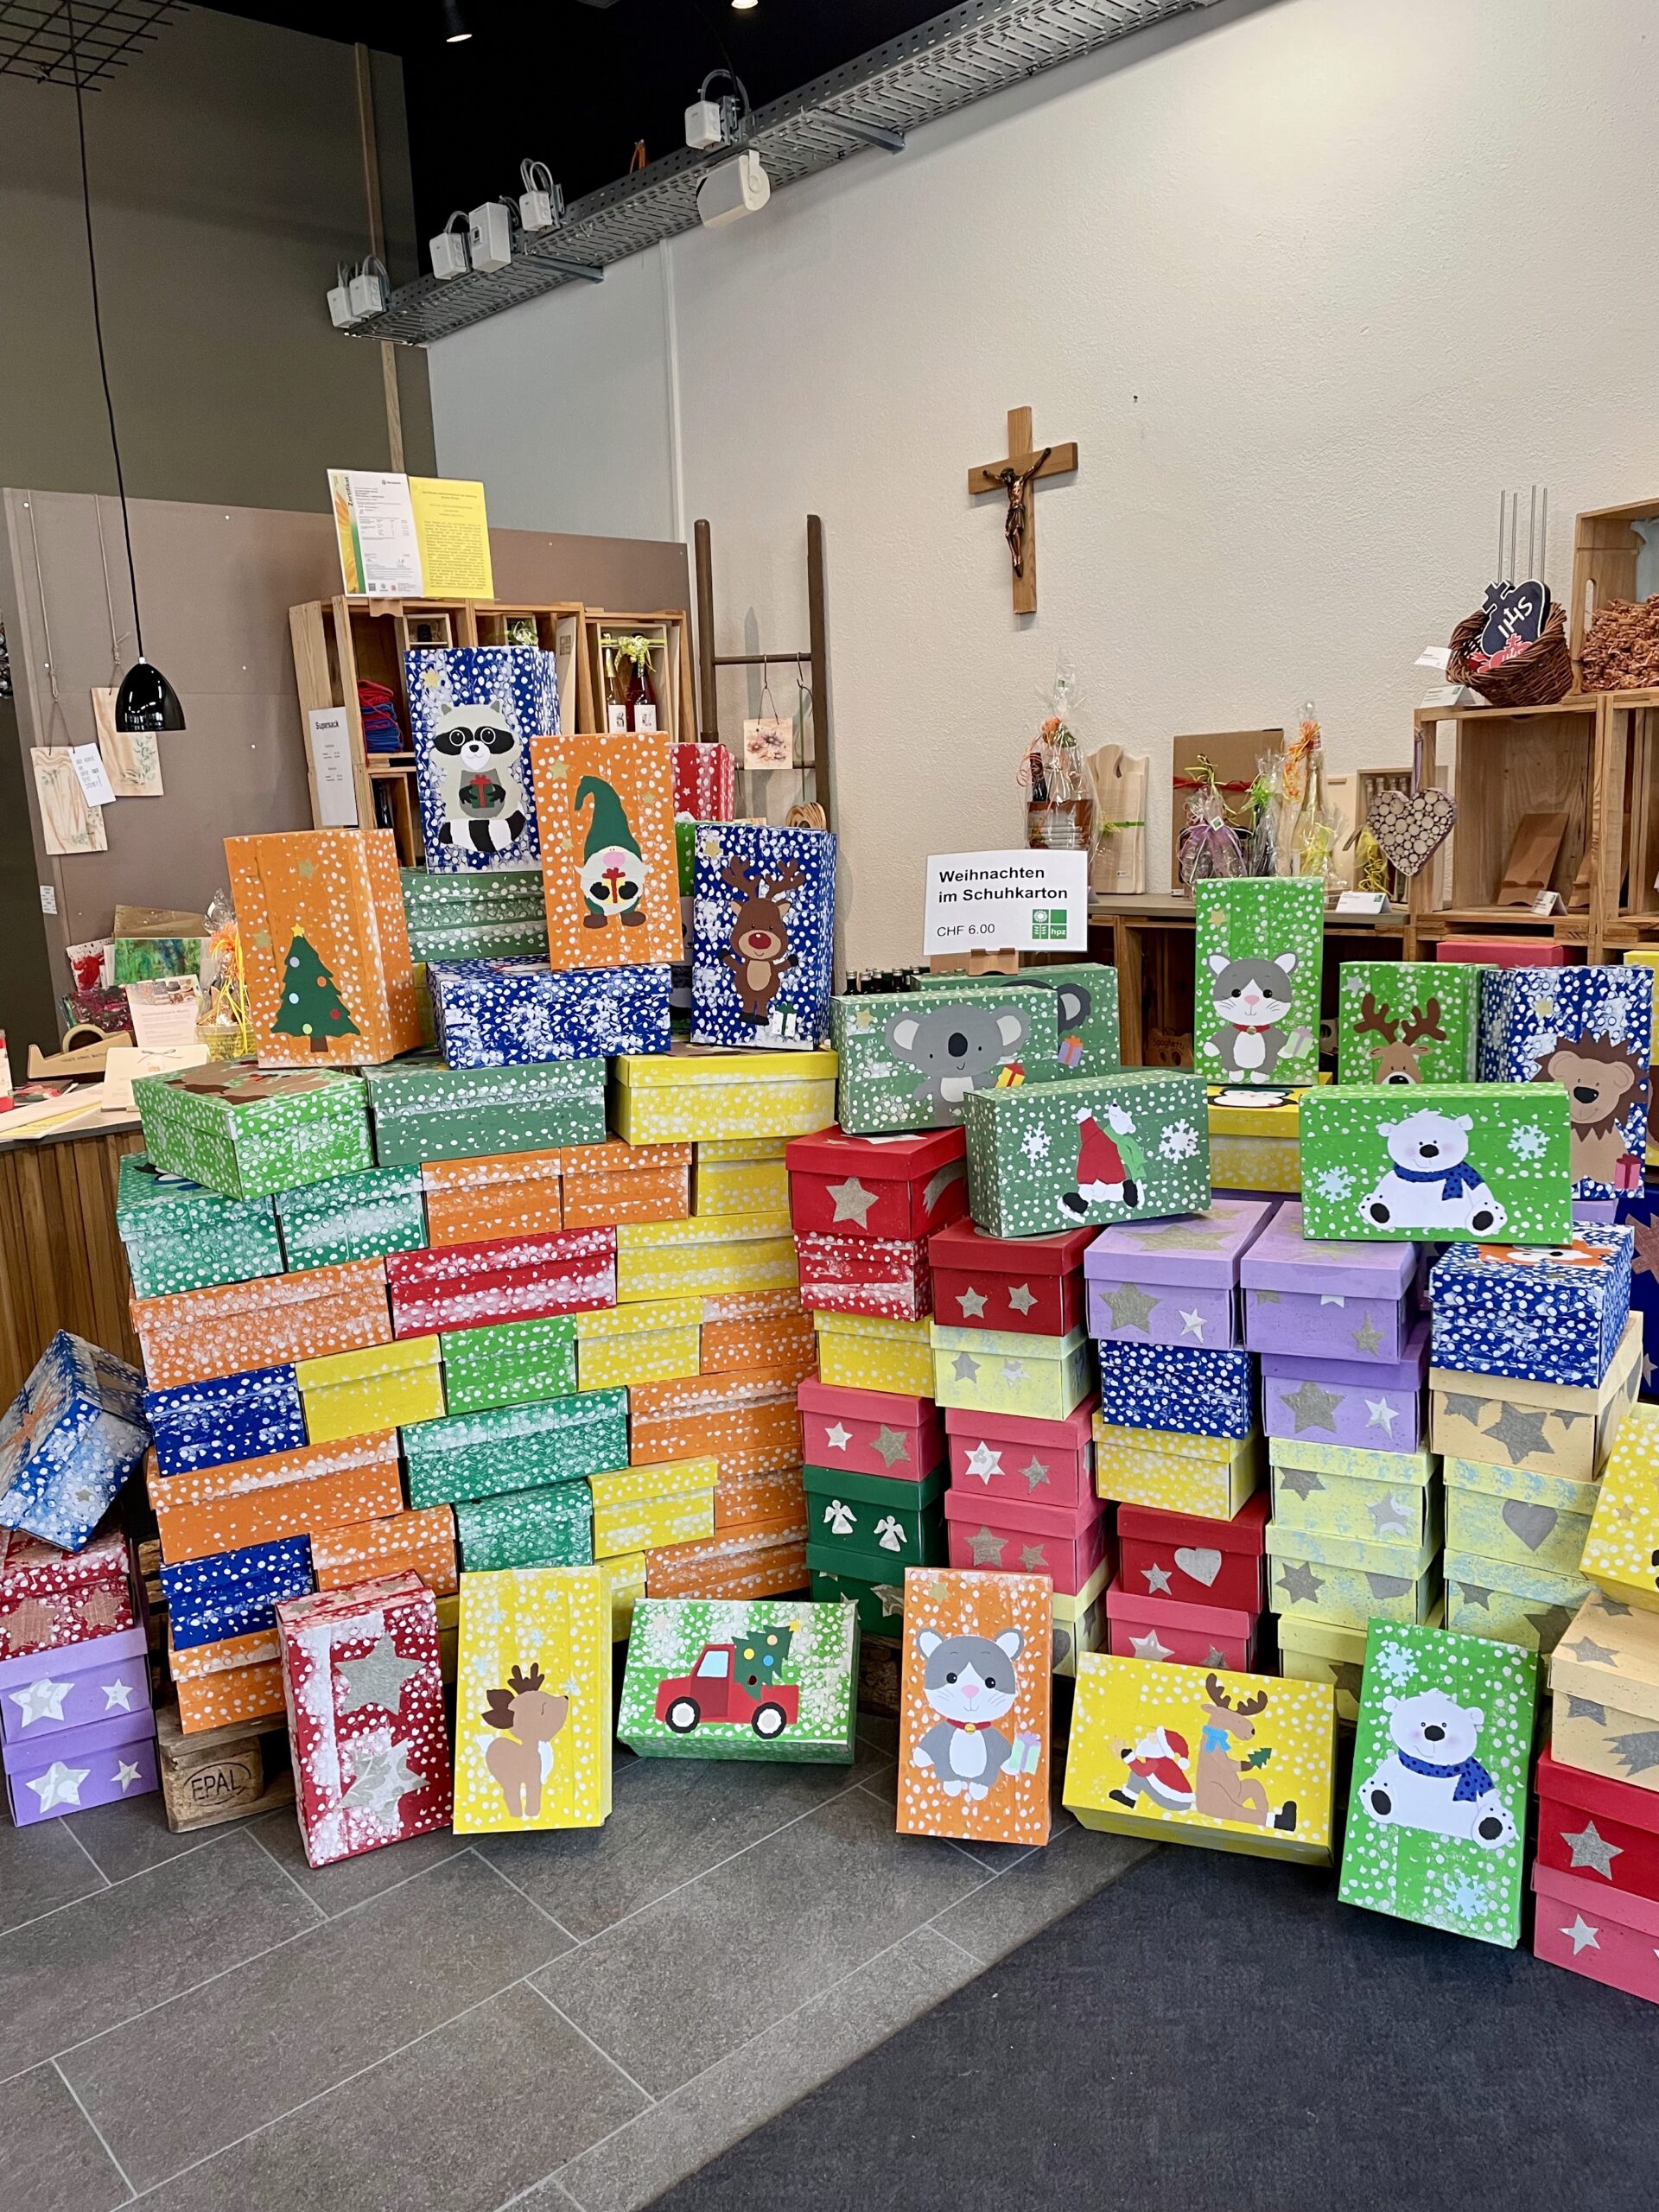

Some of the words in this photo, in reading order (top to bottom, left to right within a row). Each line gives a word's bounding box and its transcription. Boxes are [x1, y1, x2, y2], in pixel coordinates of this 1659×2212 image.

[345, 476, 353, 507] Zertifikat
[938, 867, 1045, 883] Weihnachten
[938, 891, 957, 903] im
[963, 887, 1068, 901] Schuhkarton
[937, 925, 964, 937] CHF
[968, 923, 995, 935] 6.00
[1051, 927, 1066, 937] hpz
[191, 1769, 242, 1802] EPAL
